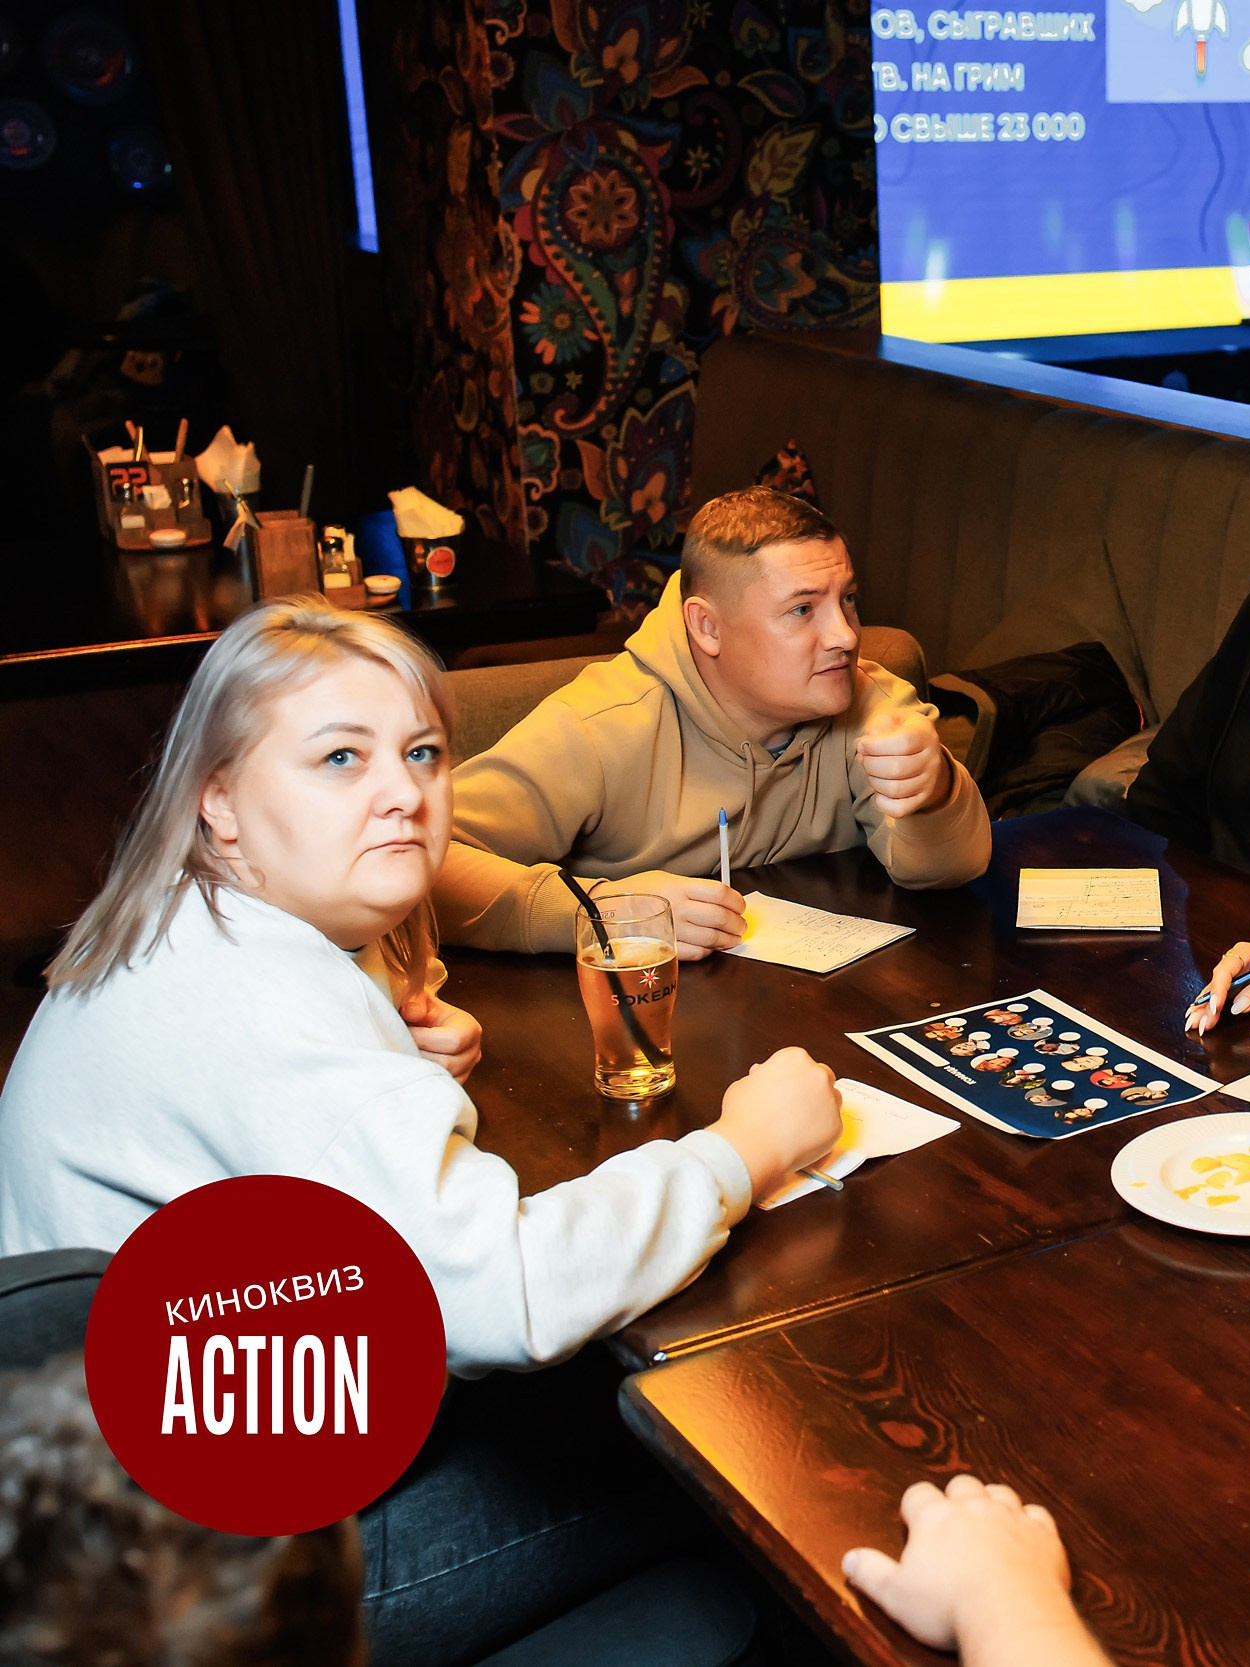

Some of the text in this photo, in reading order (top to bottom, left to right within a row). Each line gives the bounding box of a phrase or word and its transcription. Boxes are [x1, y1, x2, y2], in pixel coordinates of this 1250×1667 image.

[928, 9, 1096, 42] СЫГРАВШИХ
[911, 61, 952, 92] НА
[953, 61, 1026, 92] ГРИМ
[890, 112, 996, 143] СВЫШЕ
[997, 112, 1031, 142] 23
[1032, 111, 1086, 142] 000
